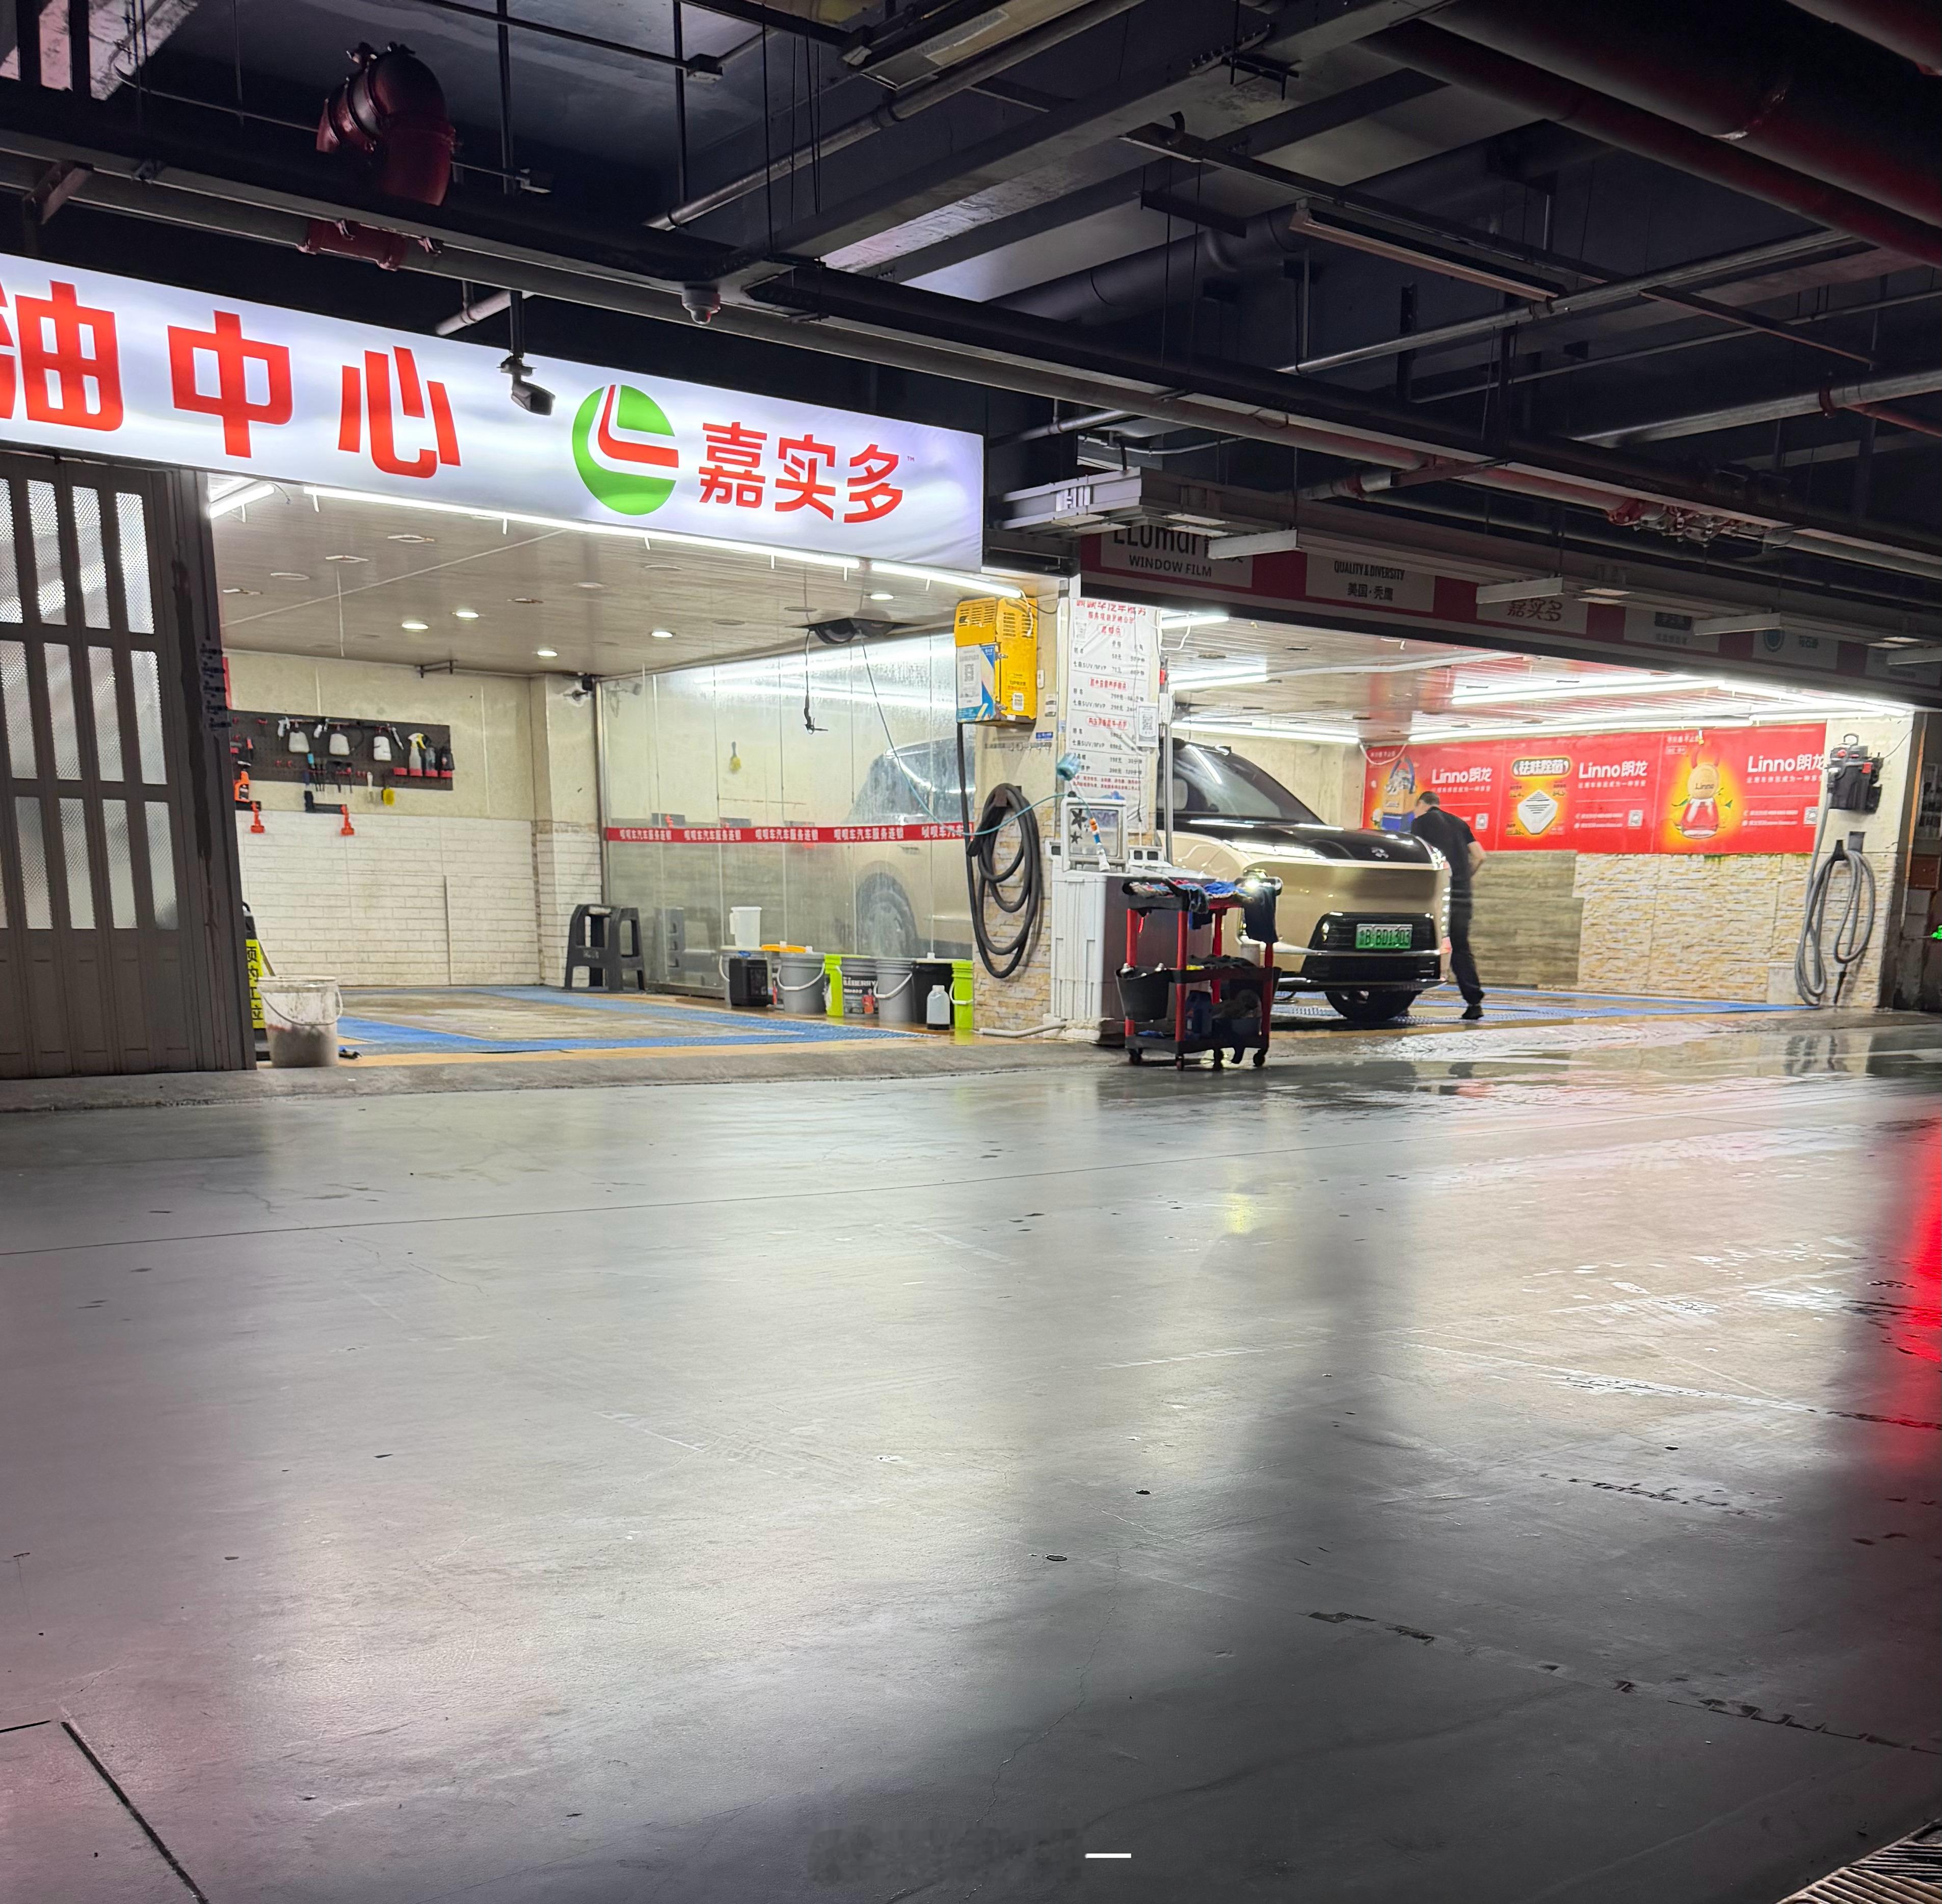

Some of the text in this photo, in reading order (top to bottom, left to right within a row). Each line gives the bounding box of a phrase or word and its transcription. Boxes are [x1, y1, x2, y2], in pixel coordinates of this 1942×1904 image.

[699, 421, 903, 523] 嘉实多
[1129, 554, 1212, 577] WINDOW FILM
